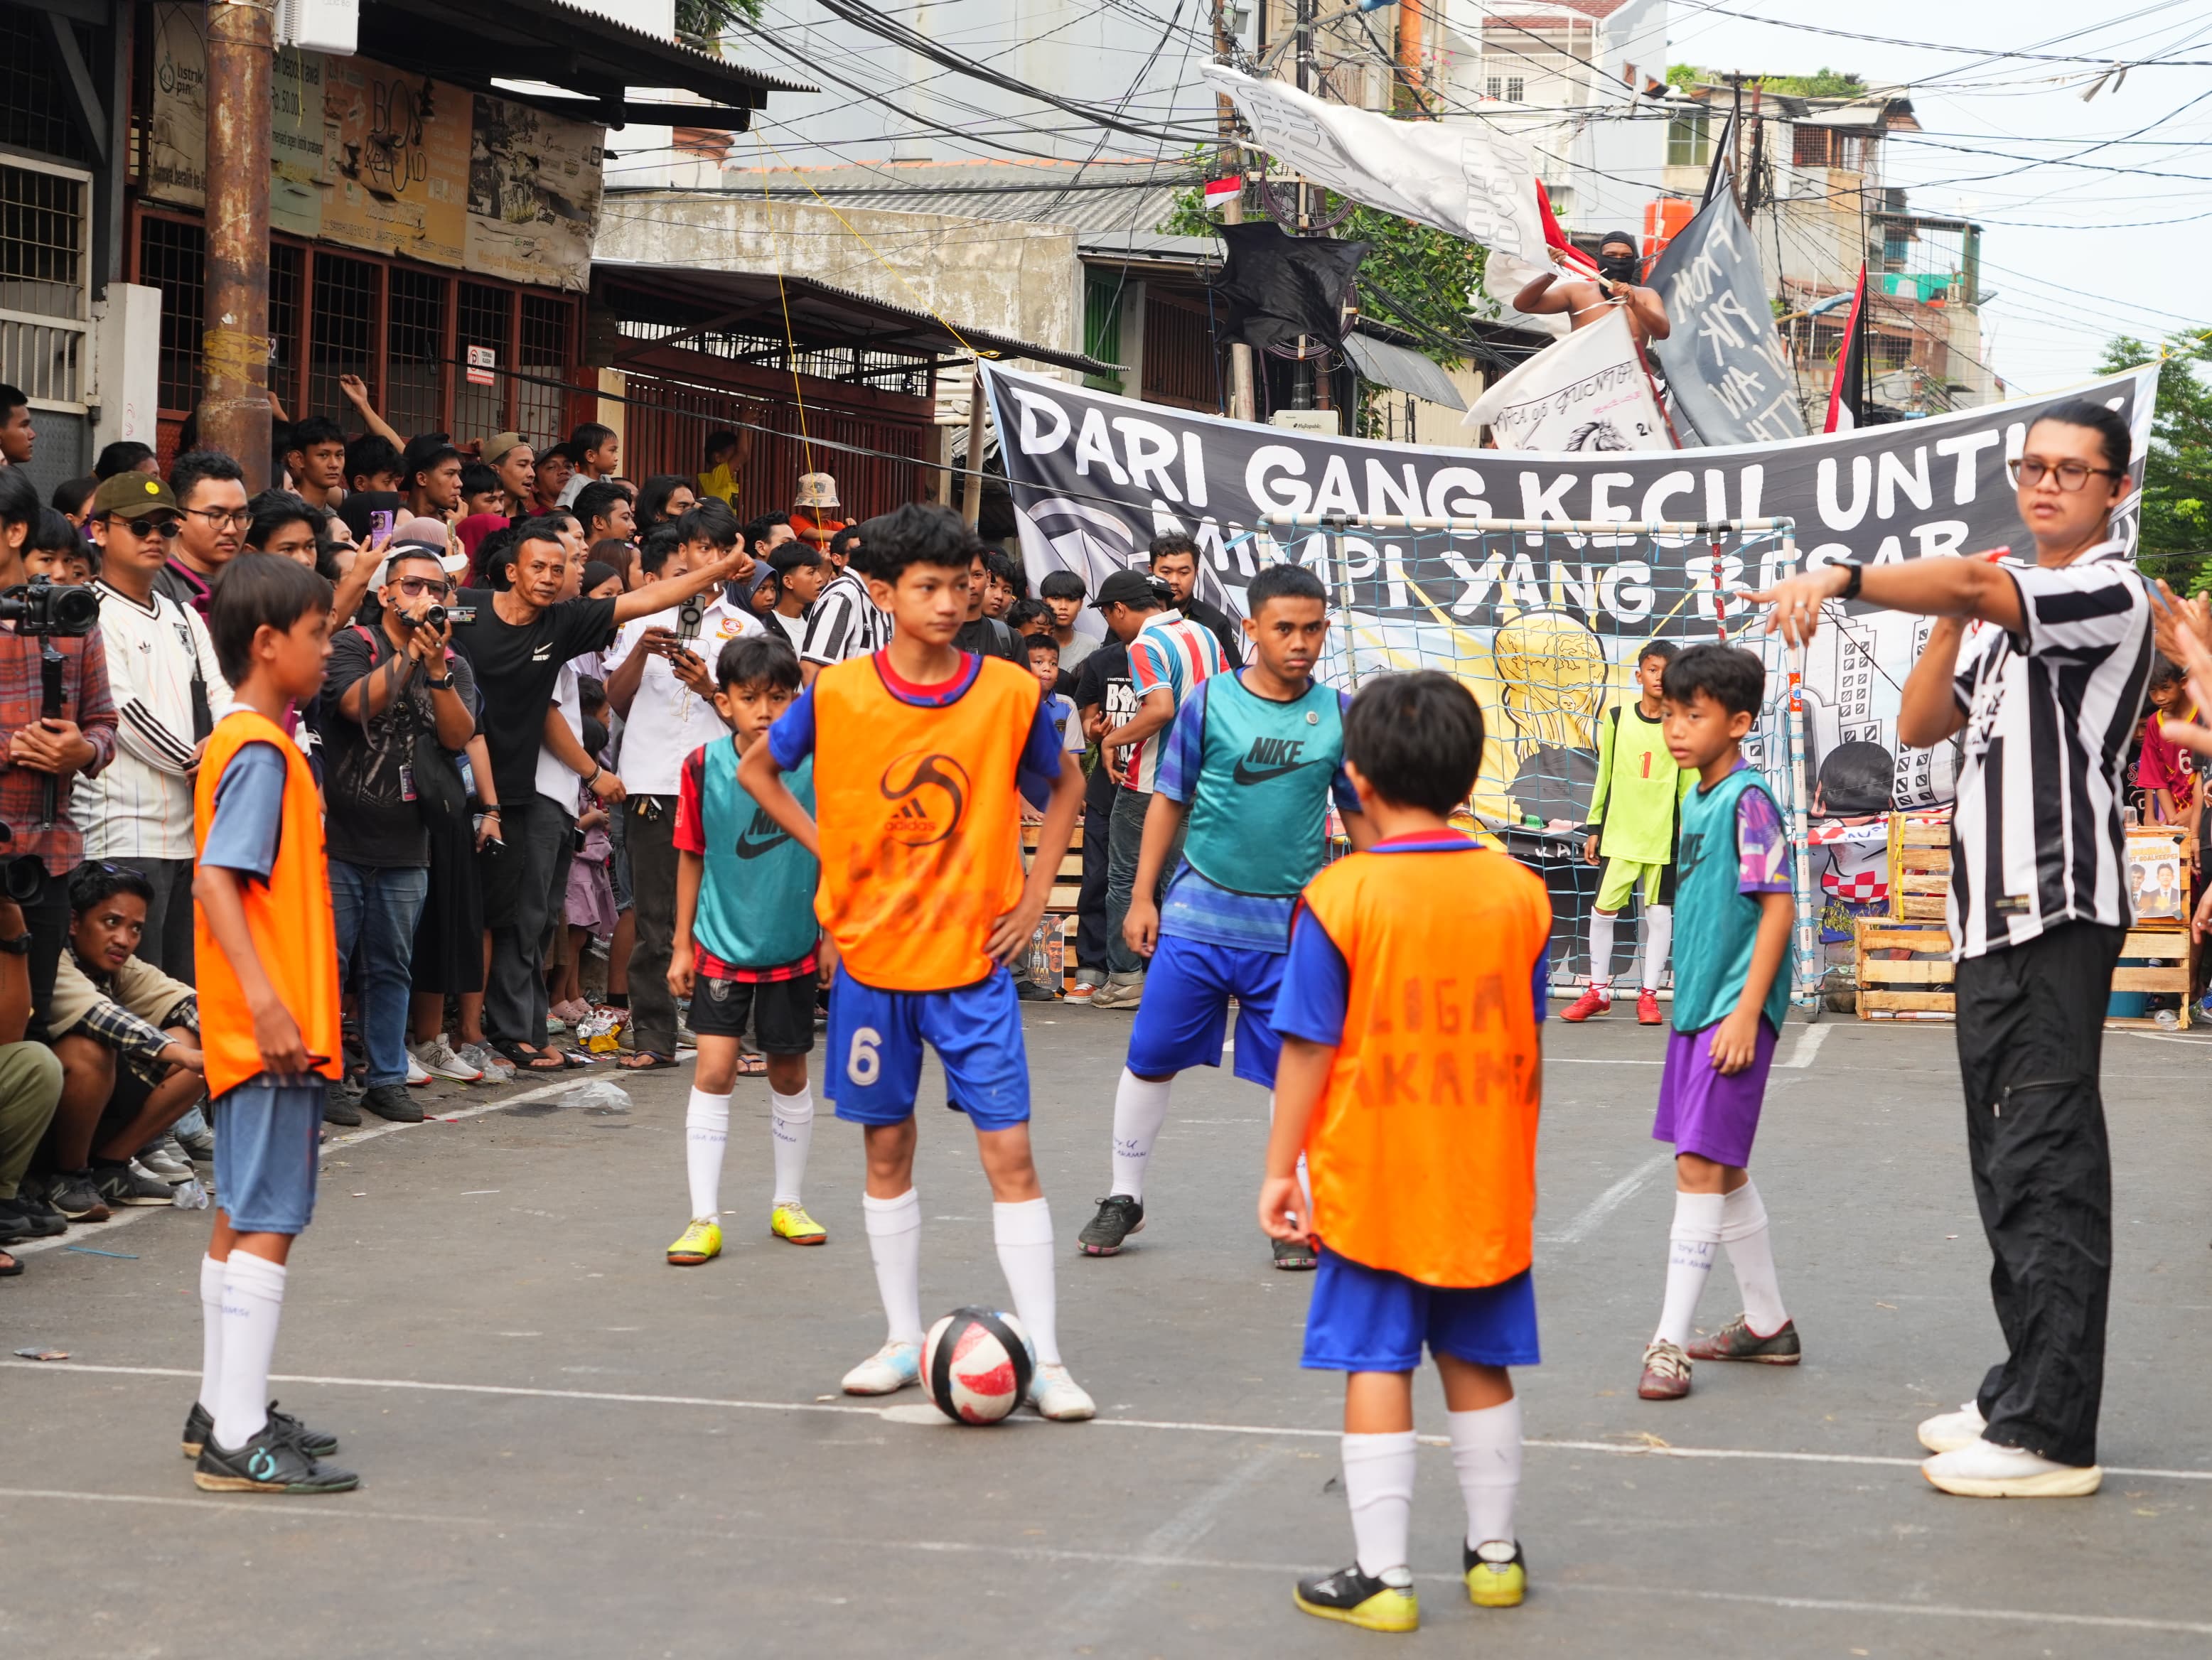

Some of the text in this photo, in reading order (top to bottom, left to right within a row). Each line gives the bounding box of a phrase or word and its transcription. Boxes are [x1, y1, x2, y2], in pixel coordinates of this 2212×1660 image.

[177, 62, 204, 84] listrik
[305, 63, 319, 86] awal
[1010, 387, 2125, 550] DARI GANG KECIL UNT
[1441, 550, 1656, 623] YANG
[1247, 736, 1305, 765] NIKE
[2178, 748, 2194, 775] 6
[1638, 751, 1653, 779] 1
[884, 821, 936, 831] adidas
[1369, 973, 1510, 1036] LIGA
[847, 1027, 881, 1087] 6
